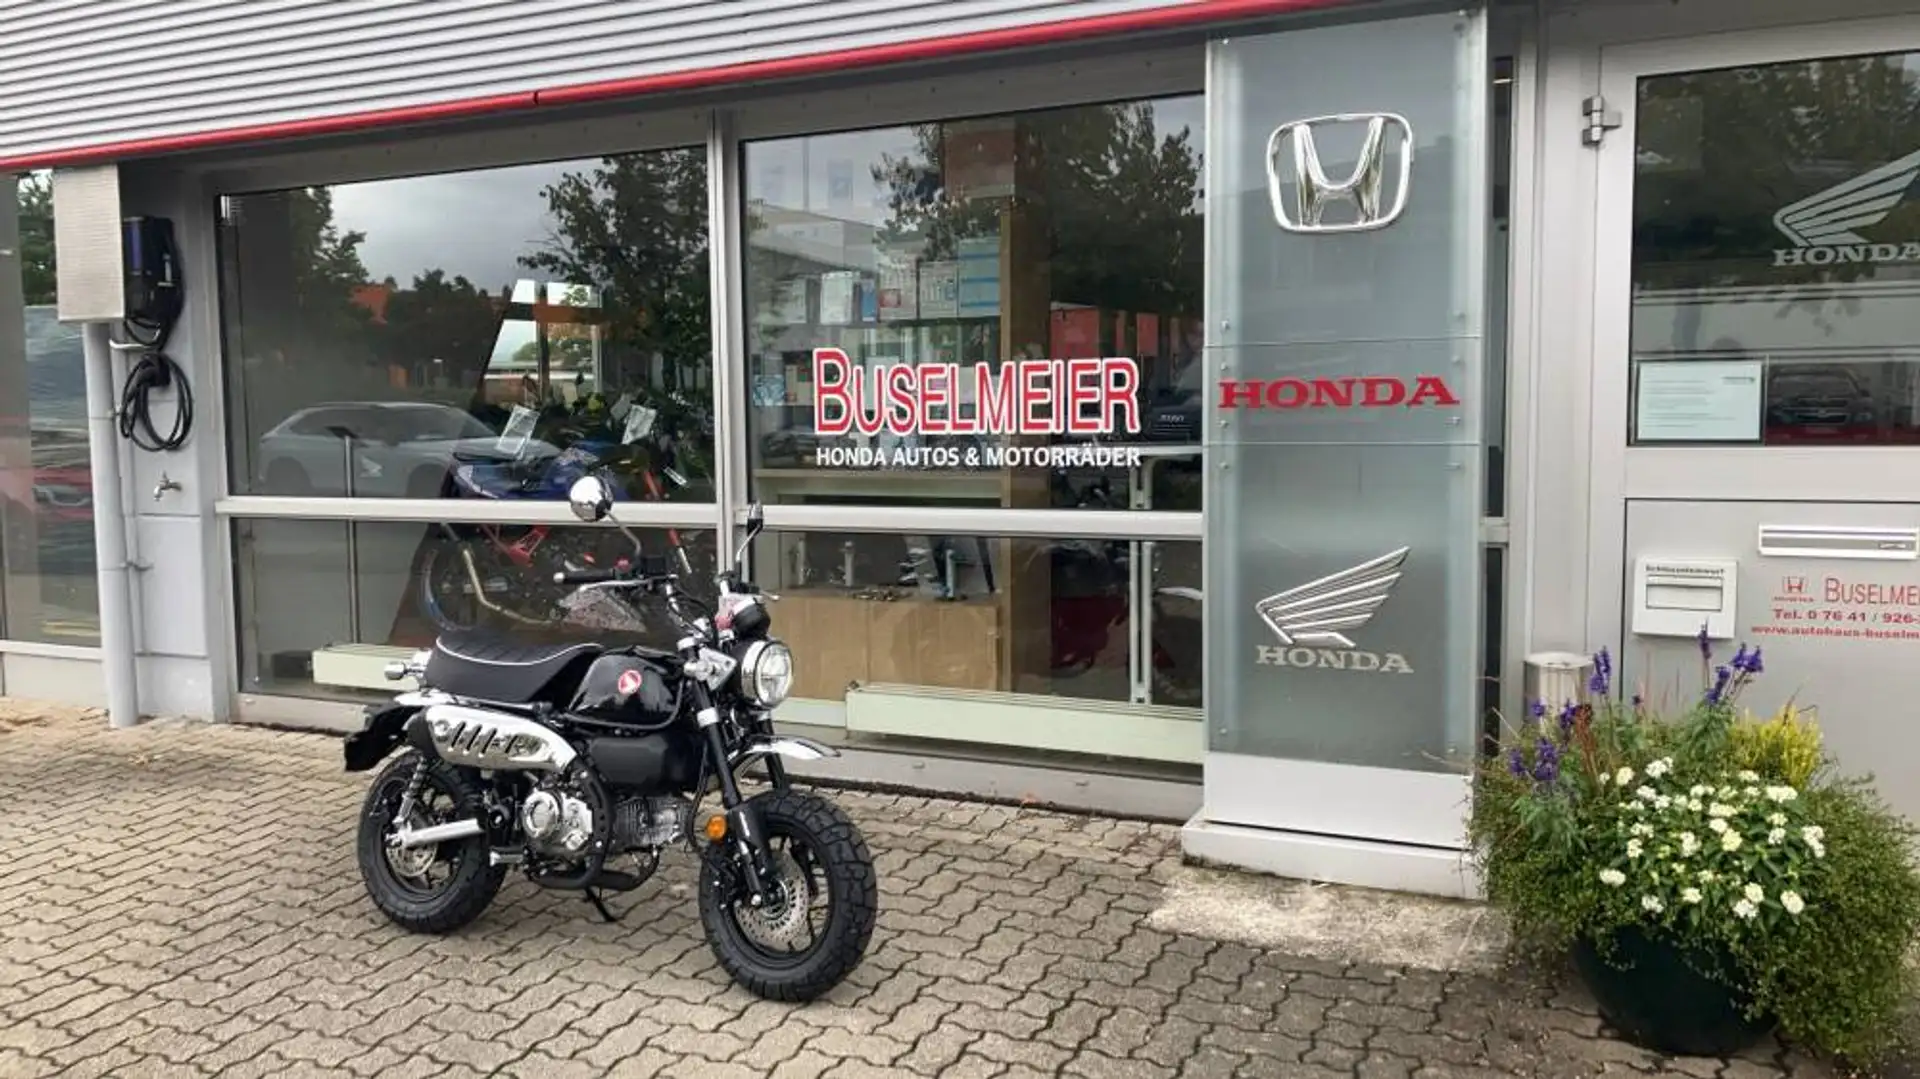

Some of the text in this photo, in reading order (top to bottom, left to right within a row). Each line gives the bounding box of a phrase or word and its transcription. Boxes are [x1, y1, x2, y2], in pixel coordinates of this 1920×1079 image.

[1772, 242, 1920, 266] HONDA
[813, 347, 1140, 437] BUSELMEIER
[1218, 376, 1461, 409] HONDA
[815, 443, 1142, 468] HONDA AUTOS & MOTORRÄDER
[1774, 608, 1802, 620] Tel.
[1808, 610, 1817, 620] 0
[1823, 610, 1843, 621] 76
[1847, 611, 1866, 622] 41
[1883, 612, 1920, 624] 926-
[1256, 645, 1415, 674] HONDA
